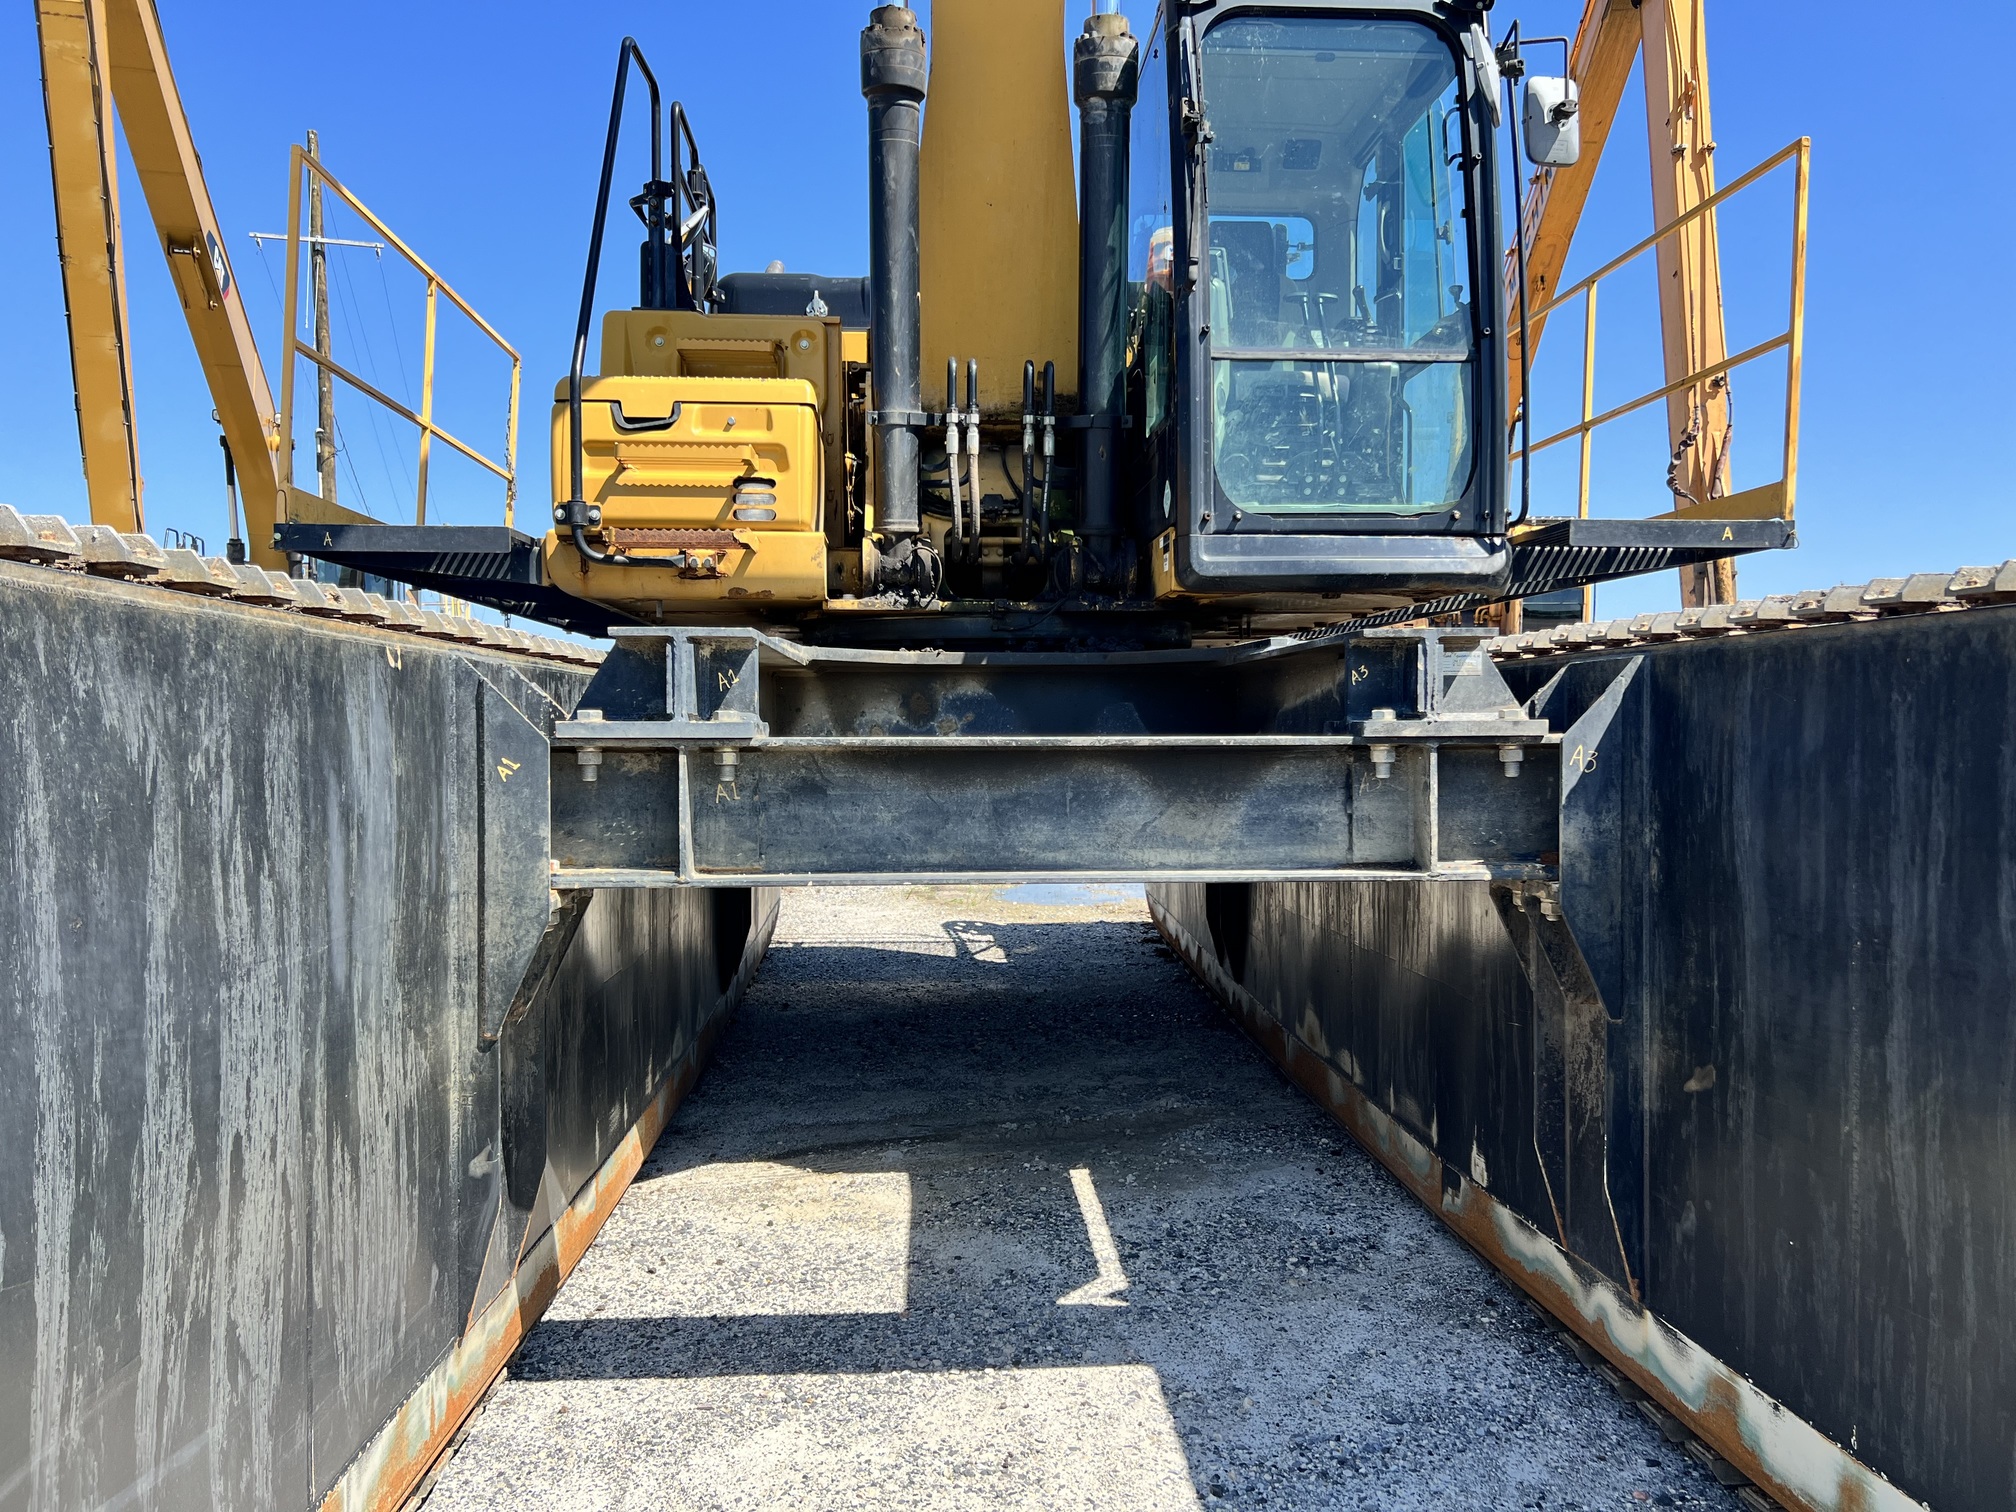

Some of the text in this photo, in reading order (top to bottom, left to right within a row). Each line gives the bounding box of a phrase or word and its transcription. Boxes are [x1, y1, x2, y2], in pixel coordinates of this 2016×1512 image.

[323, 532, 333, 547] A
[1722, 527, 1733, 541] A
[718, 668, 740, 692] A1
[1351, 664, 1370, 686] A3
[497, 757, 521, 782] A1
[1569, 744, 1599, 774] A3
[714, 782, 742, 804] A1
